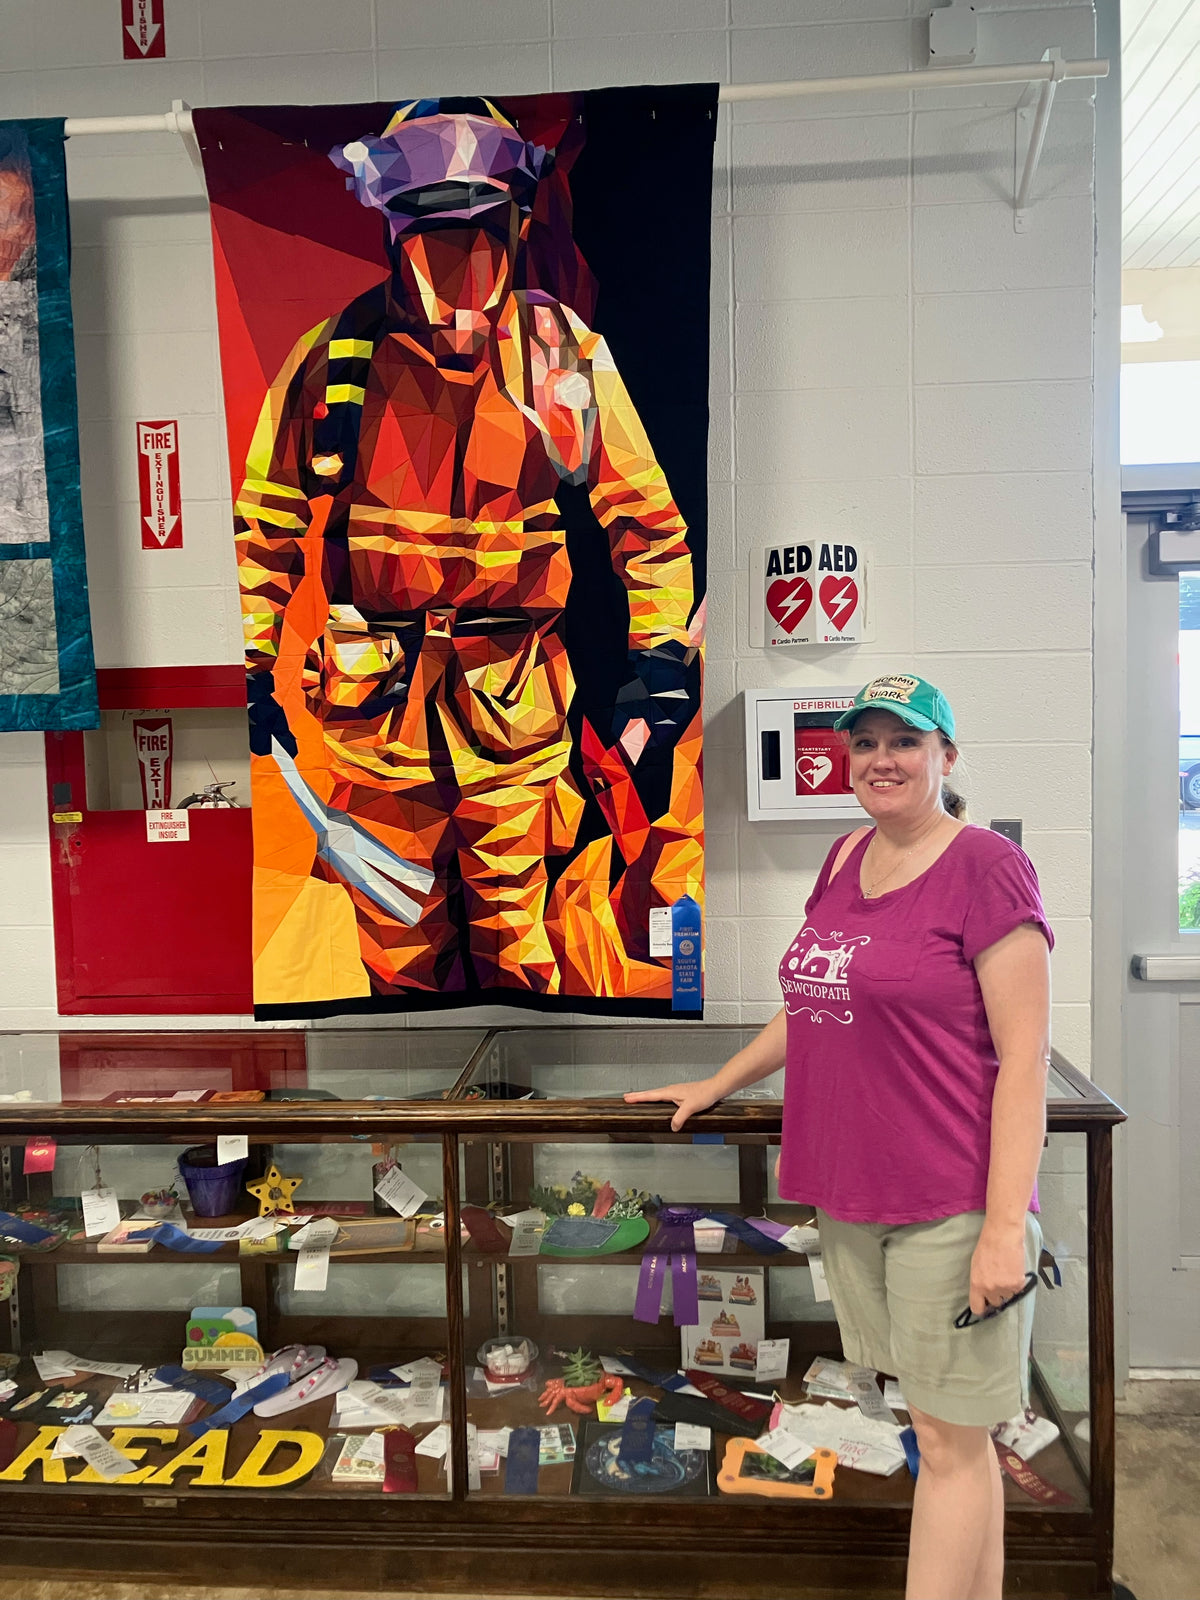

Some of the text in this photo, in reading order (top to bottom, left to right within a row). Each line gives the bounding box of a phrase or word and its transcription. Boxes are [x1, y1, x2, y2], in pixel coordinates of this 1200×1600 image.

[143, 432, 171, 449] FIRE
[155, 452, 166, 536] EXTINGUISHER
[766, 545, 812, 577] AED
[818, 544, 858, 572] AED
[873, 676, 914, 686] MOMMY
[870, 690, 905, 700] SHARK
[139, 735, 168, 751] FIRE
[150, 758, 162, 809] EXTIN
[161, 812, 173, 820] FIRE
[149, 821, 187, 830] EXTINGUISHER
[158, 831, 178, 839] INSIDE
[780, 976, 851, 1001] SEWCIOPATH
[184, 1348, 258, 1362] SUMMER
